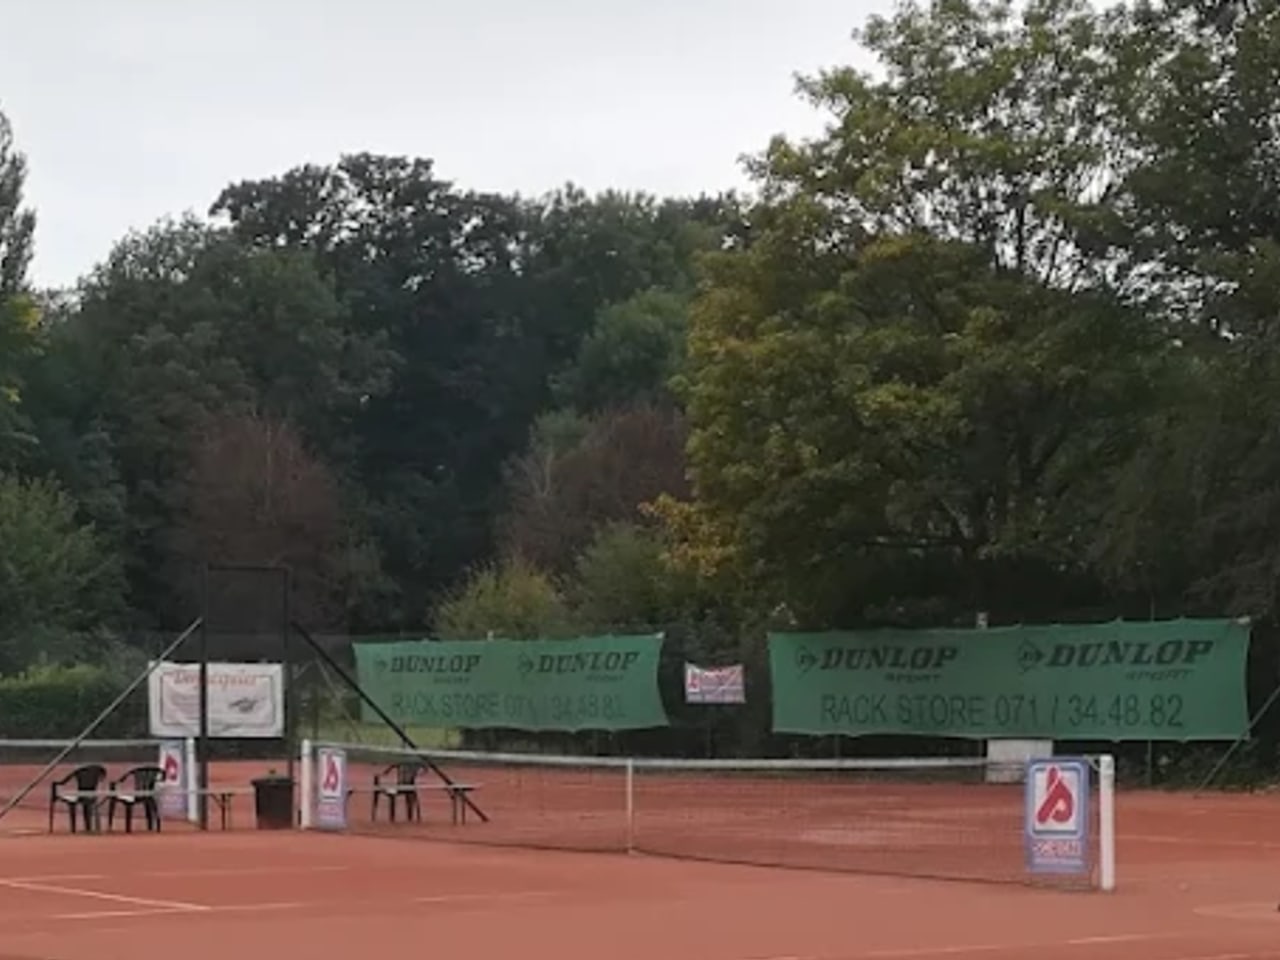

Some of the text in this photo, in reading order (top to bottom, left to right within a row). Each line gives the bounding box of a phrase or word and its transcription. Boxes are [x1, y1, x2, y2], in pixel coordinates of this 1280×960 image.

[389, 654, 482, 673] DUNLOP
[538, 651, 641, 673] DUNLOP
[819, 646, 959, 670] DUNLOP
[1050, 640, 1215, 667] DUNLOP
[821, 693, 888, 724] RACK
[896, 694, 985, 727] STORE
[994, 694, 1038, 727] 071
[1068, 693, 1184, 728] 34.48.82
